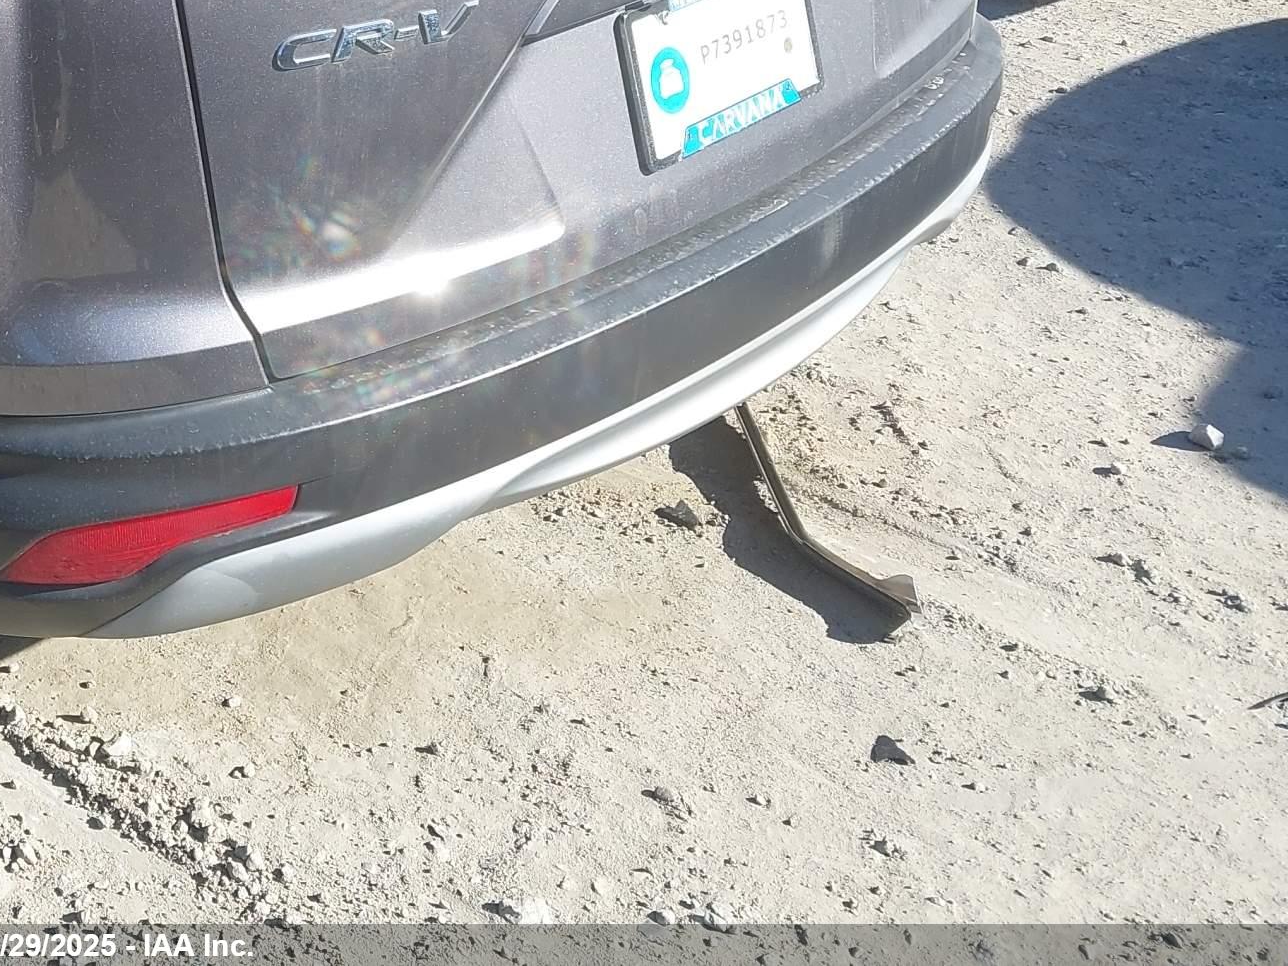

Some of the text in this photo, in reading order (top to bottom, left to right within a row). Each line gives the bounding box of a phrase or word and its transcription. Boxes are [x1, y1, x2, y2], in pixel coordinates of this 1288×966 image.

[272, 0, 479, 71] CR-V
[700, 9, 788, 65] P7391873
[697, 84, 786, 148] CARVANA
